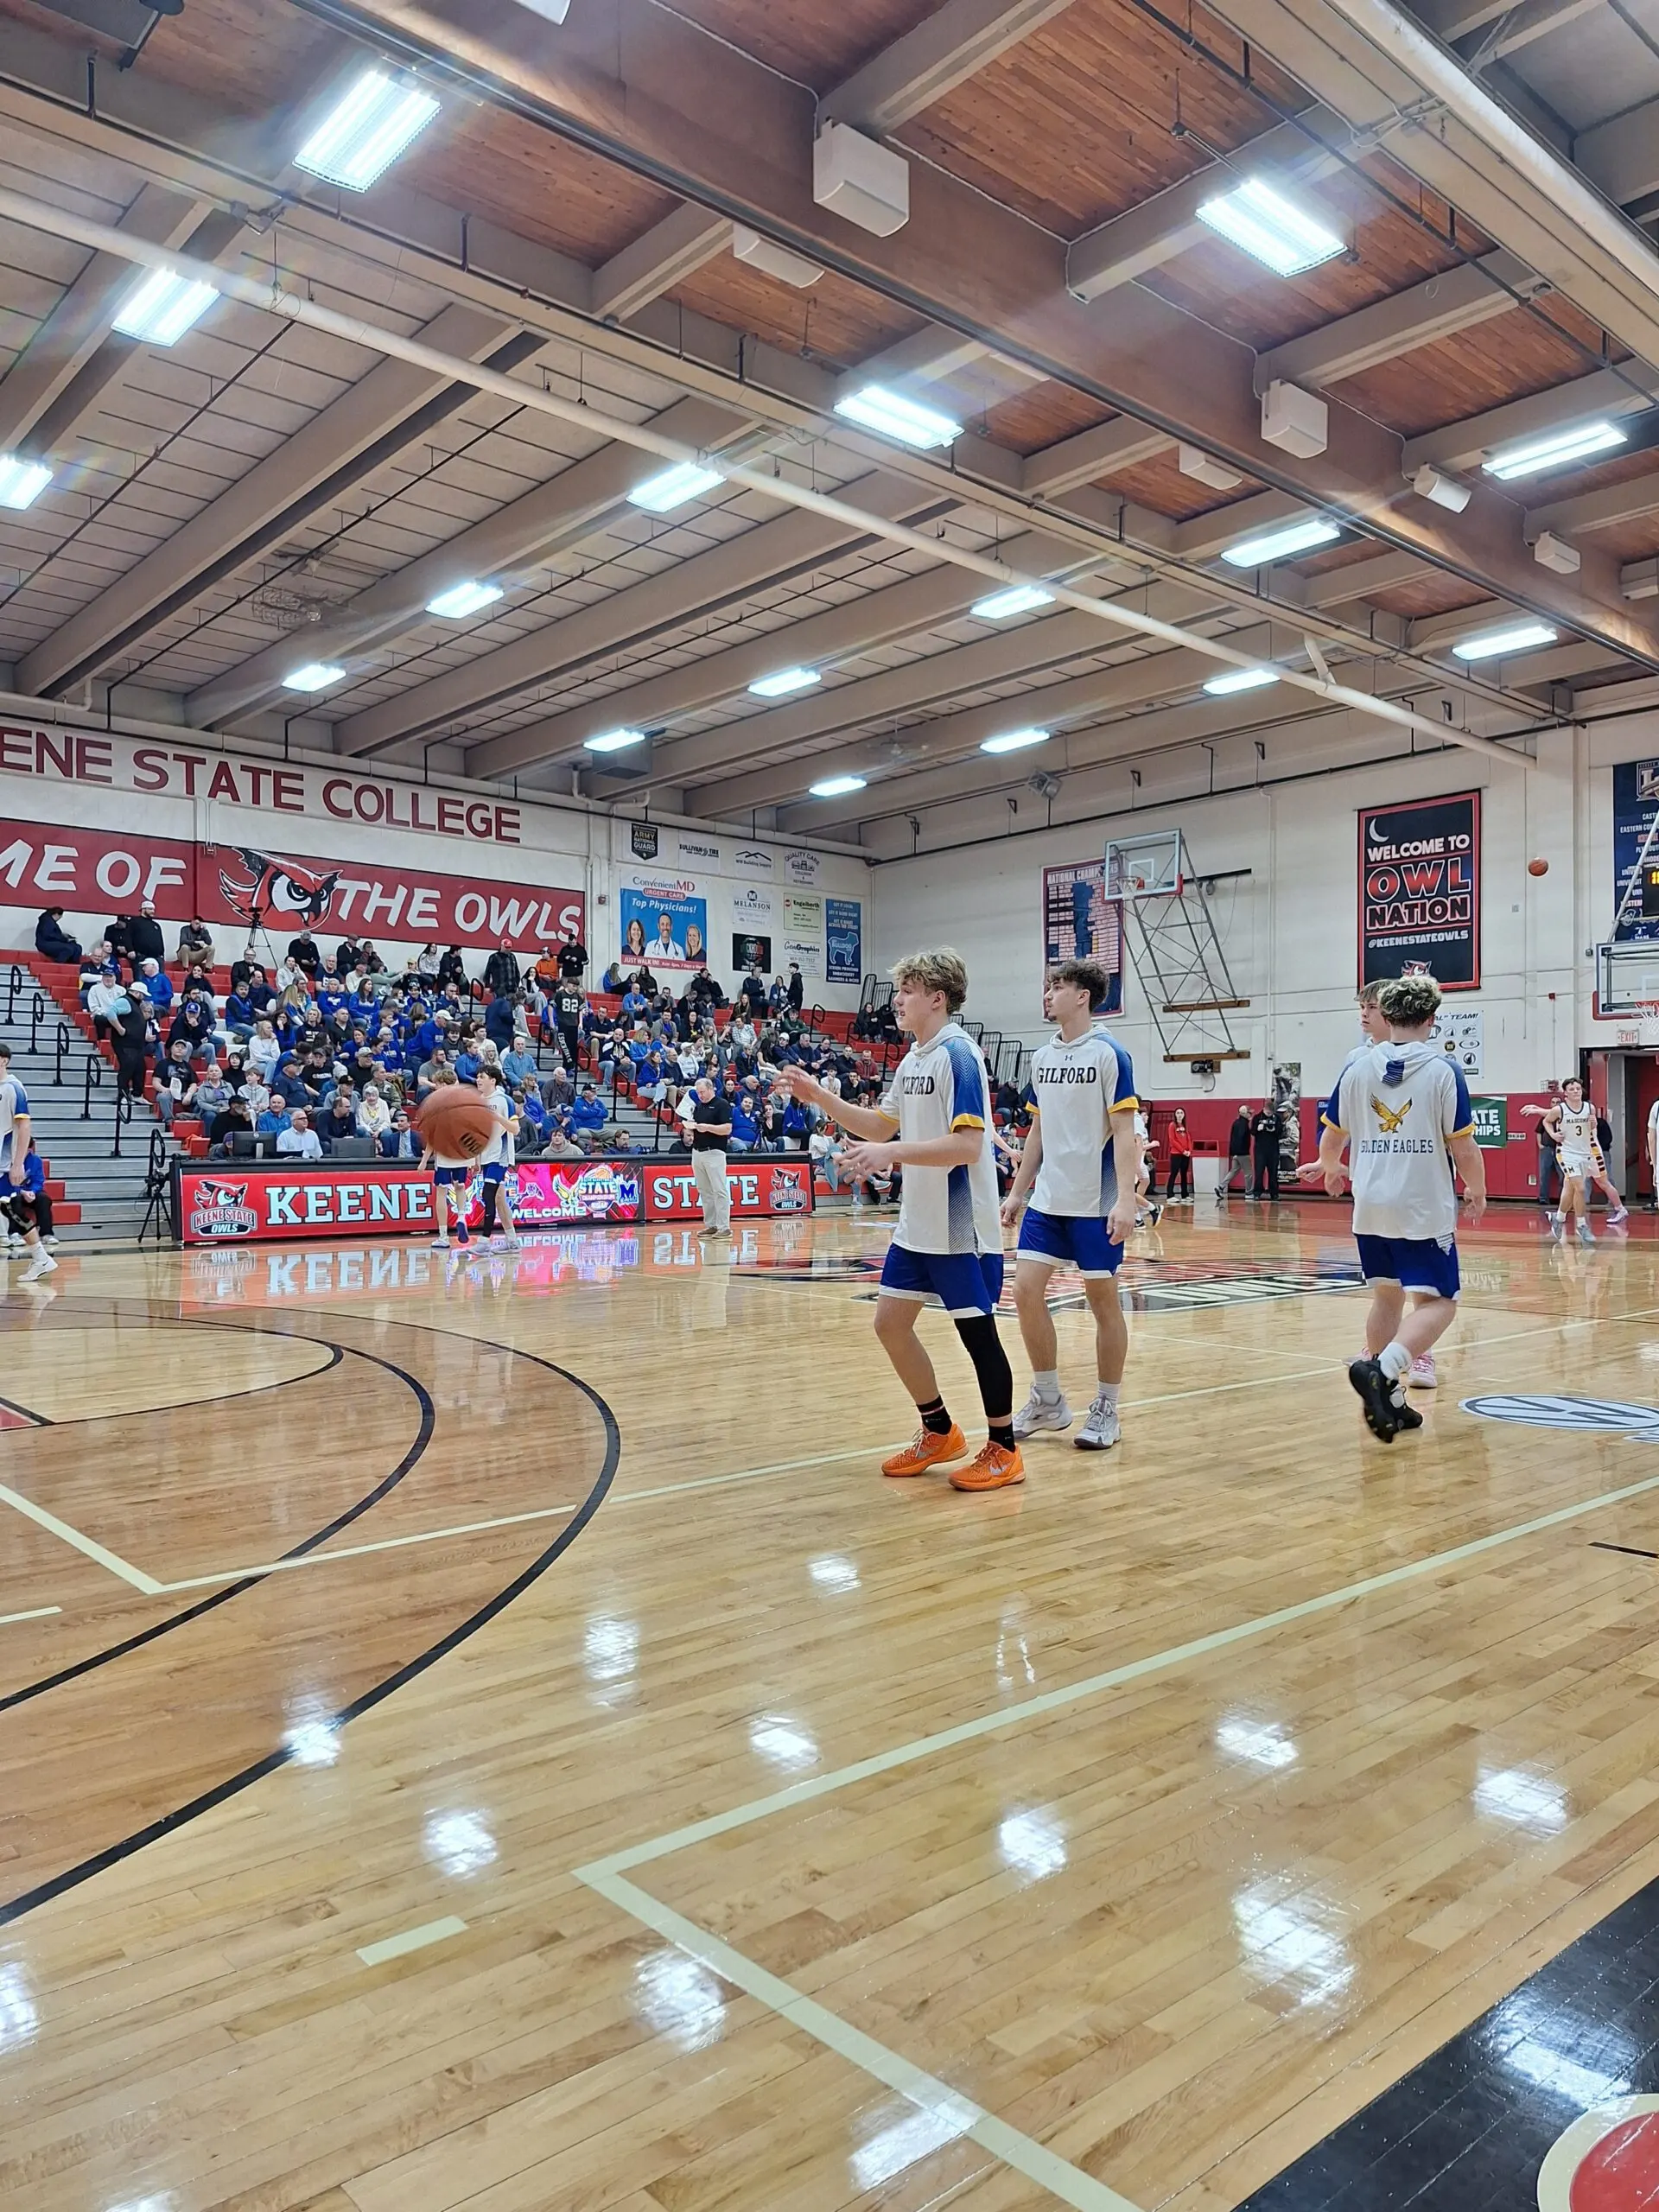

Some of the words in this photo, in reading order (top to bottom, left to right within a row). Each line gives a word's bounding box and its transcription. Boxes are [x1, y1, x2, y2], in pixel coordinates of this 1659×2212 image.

[133, 748, 304, 810] STATE
[321, 779, 520, 844] COLLEGE
[634, 830, 655, 840] ARMY
[1620, 824, 1643, 833] EASTERN
[633, 842, 656, 851] GUARD
[679, 843, 702, 852] SULLIVAN
[1367, 837, 1445, 862] WELCOME
[1447, 834, 1471, 851] TO
[785, 851, 806, 861] QUALITY
[806, 853, 820, 865] CARE
[632, 876, 695, 892] ConvenientMD
[1047, 870, 1076, 885] NATIONAL
[1366, 856, 1471, 903] OWL
[96, 851, 187, 901] OF
[334, 878, 441, 927] THE
[454, 892, 582, 943] OWLS
[734, 899, 771, 910] MELANSON
[632, 898, 647, 909] Top
[649, 899, 697, 913] Physicians!
[1366, 894, 1471, 931] NATION
[1368, 929, 1469, 949] @KEENESTATEOWLS
[562, 998, 579, 1013] 82
[1620, 1032, 1635, 1042] EXIT
[1039, 1066, 1096, 1084] GILFORD
[1471, 1109, 1499, 1124] ATE
[1575, 1125, 1582, 1136] 3
[1393, 1140, 1433, 1153] EAGLES
[579, 1181, 617, 1194] STATE
[620, 1183, 636, 1198] M
[654, 1175, 760, 1210] STTE
[265, 1183, 432, 1225] KEENE
[194, 1210, 225, 1226] KEENE
[225, 1209, 254, 1224] STATE
[512, 1206, 587, 1219] WELCOME
[211, 1223, 238, 1234] OWLS
